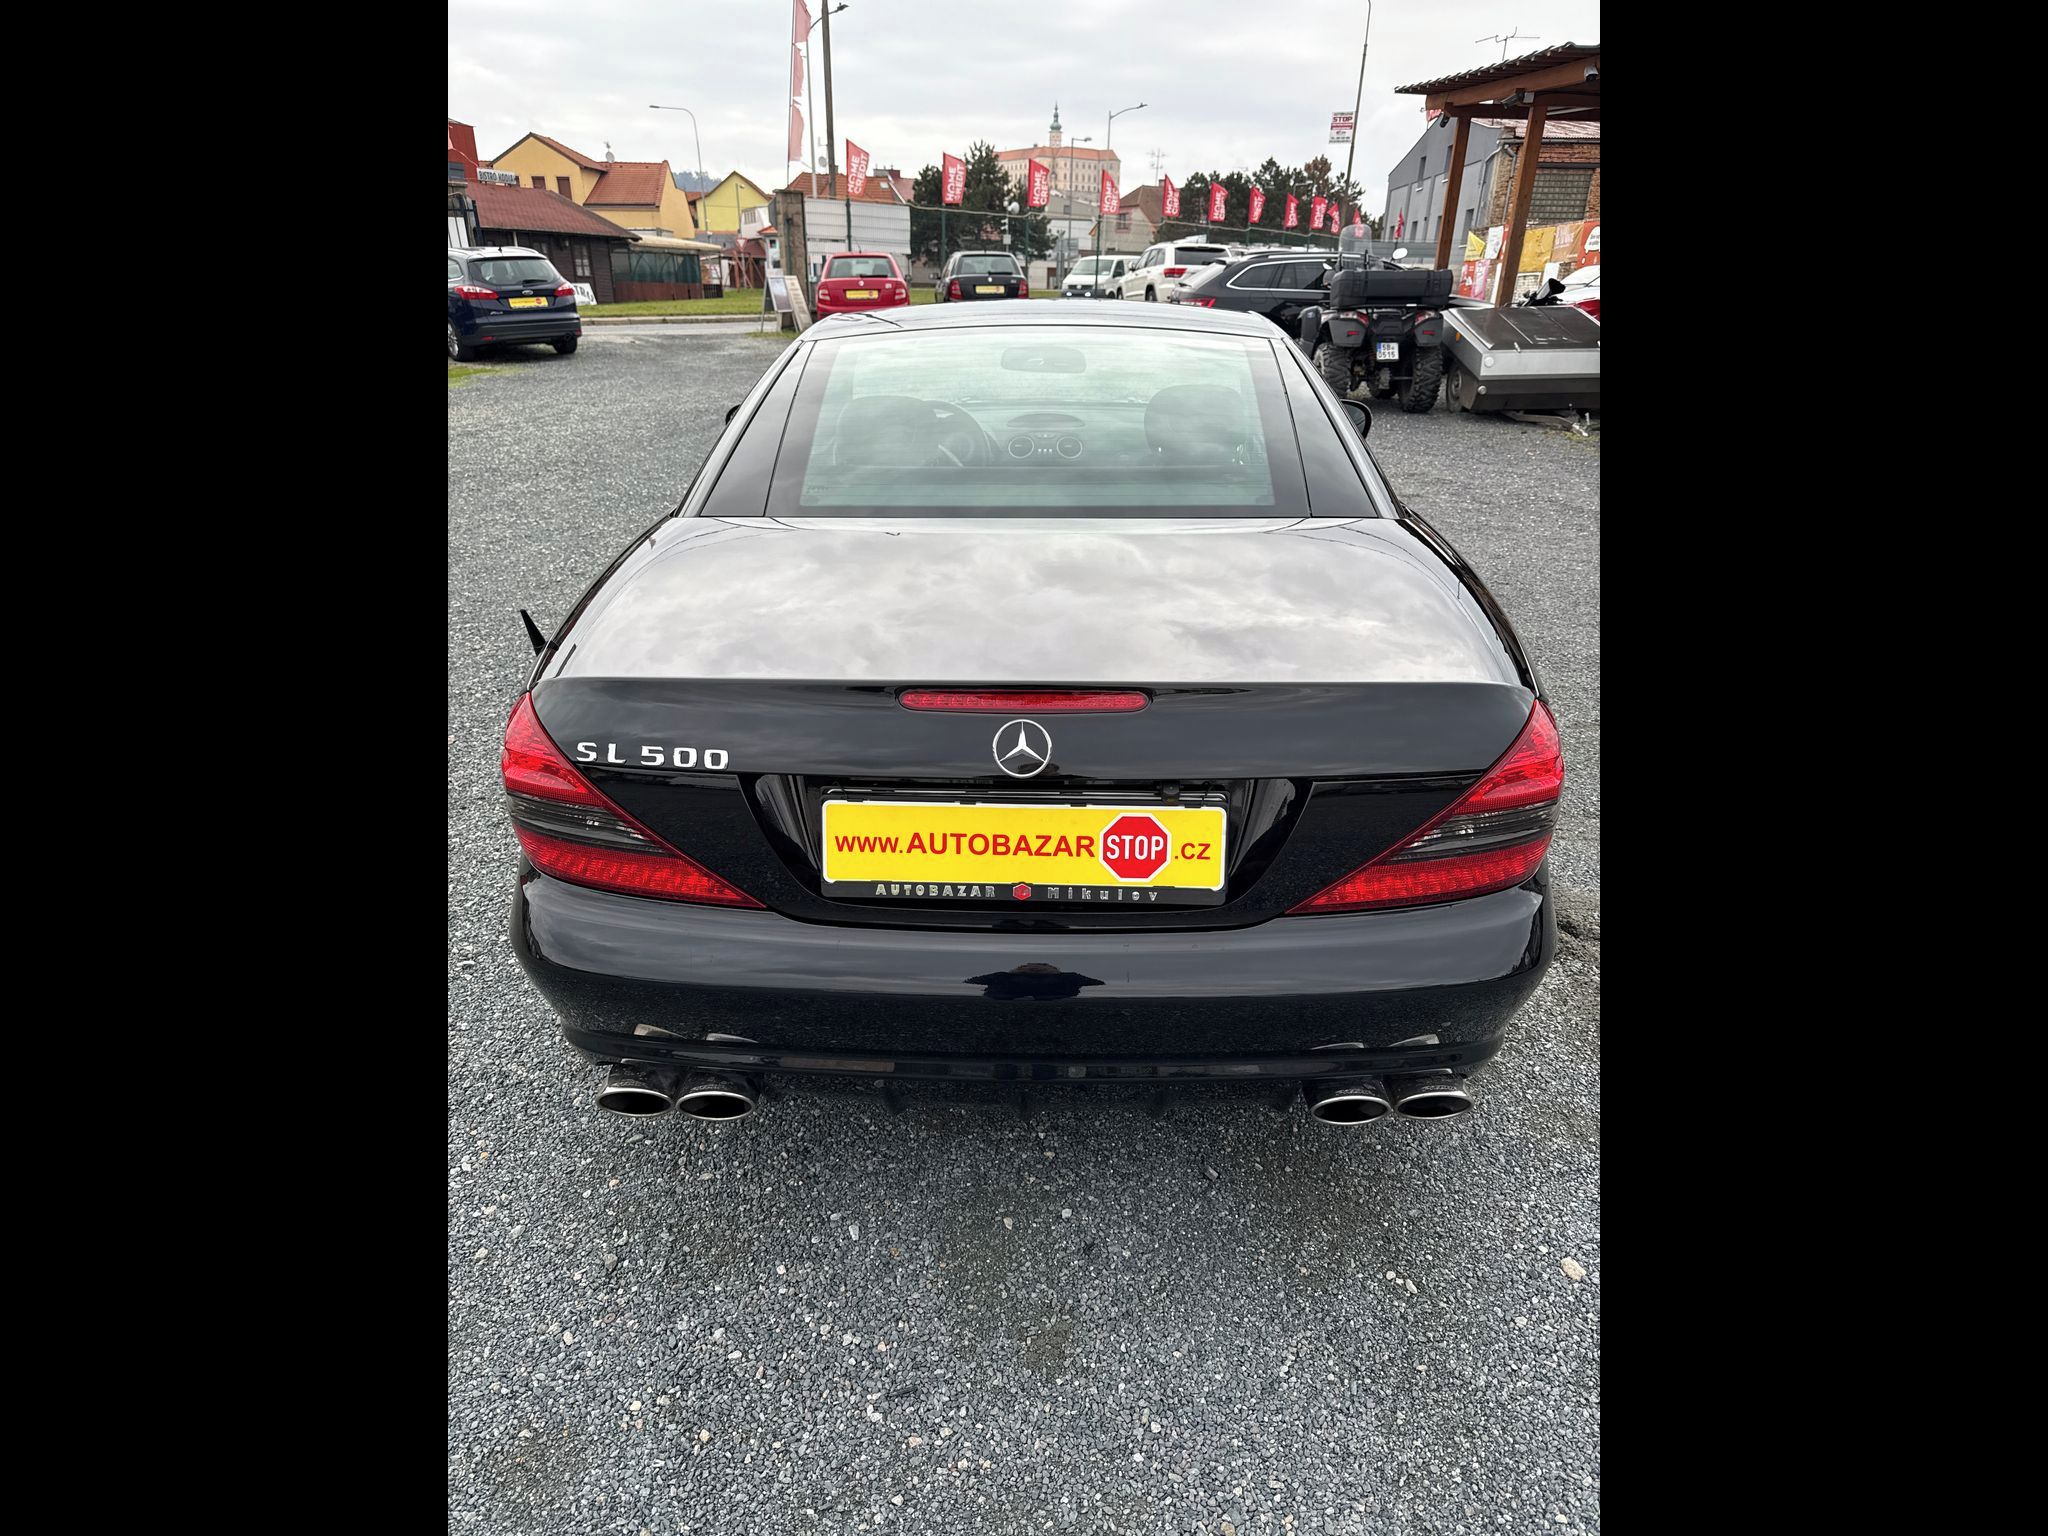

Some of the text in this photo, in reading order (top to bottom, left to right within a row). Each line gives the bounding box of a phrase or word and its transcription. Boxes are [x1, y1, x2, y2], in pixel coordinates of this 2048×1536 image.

[848, 155, 860, 193] HOME
[854, 152, 868, 194] CREDIT
[945, 166, 956, 201] HOME
[1032, 170, 1042, 204] HOME
[576, 742, 729, 770] SL 500
[1106, 834, 1165, 861] STOP
[875, 883, 1158, 901] AUTOBAZAR Mikulov
